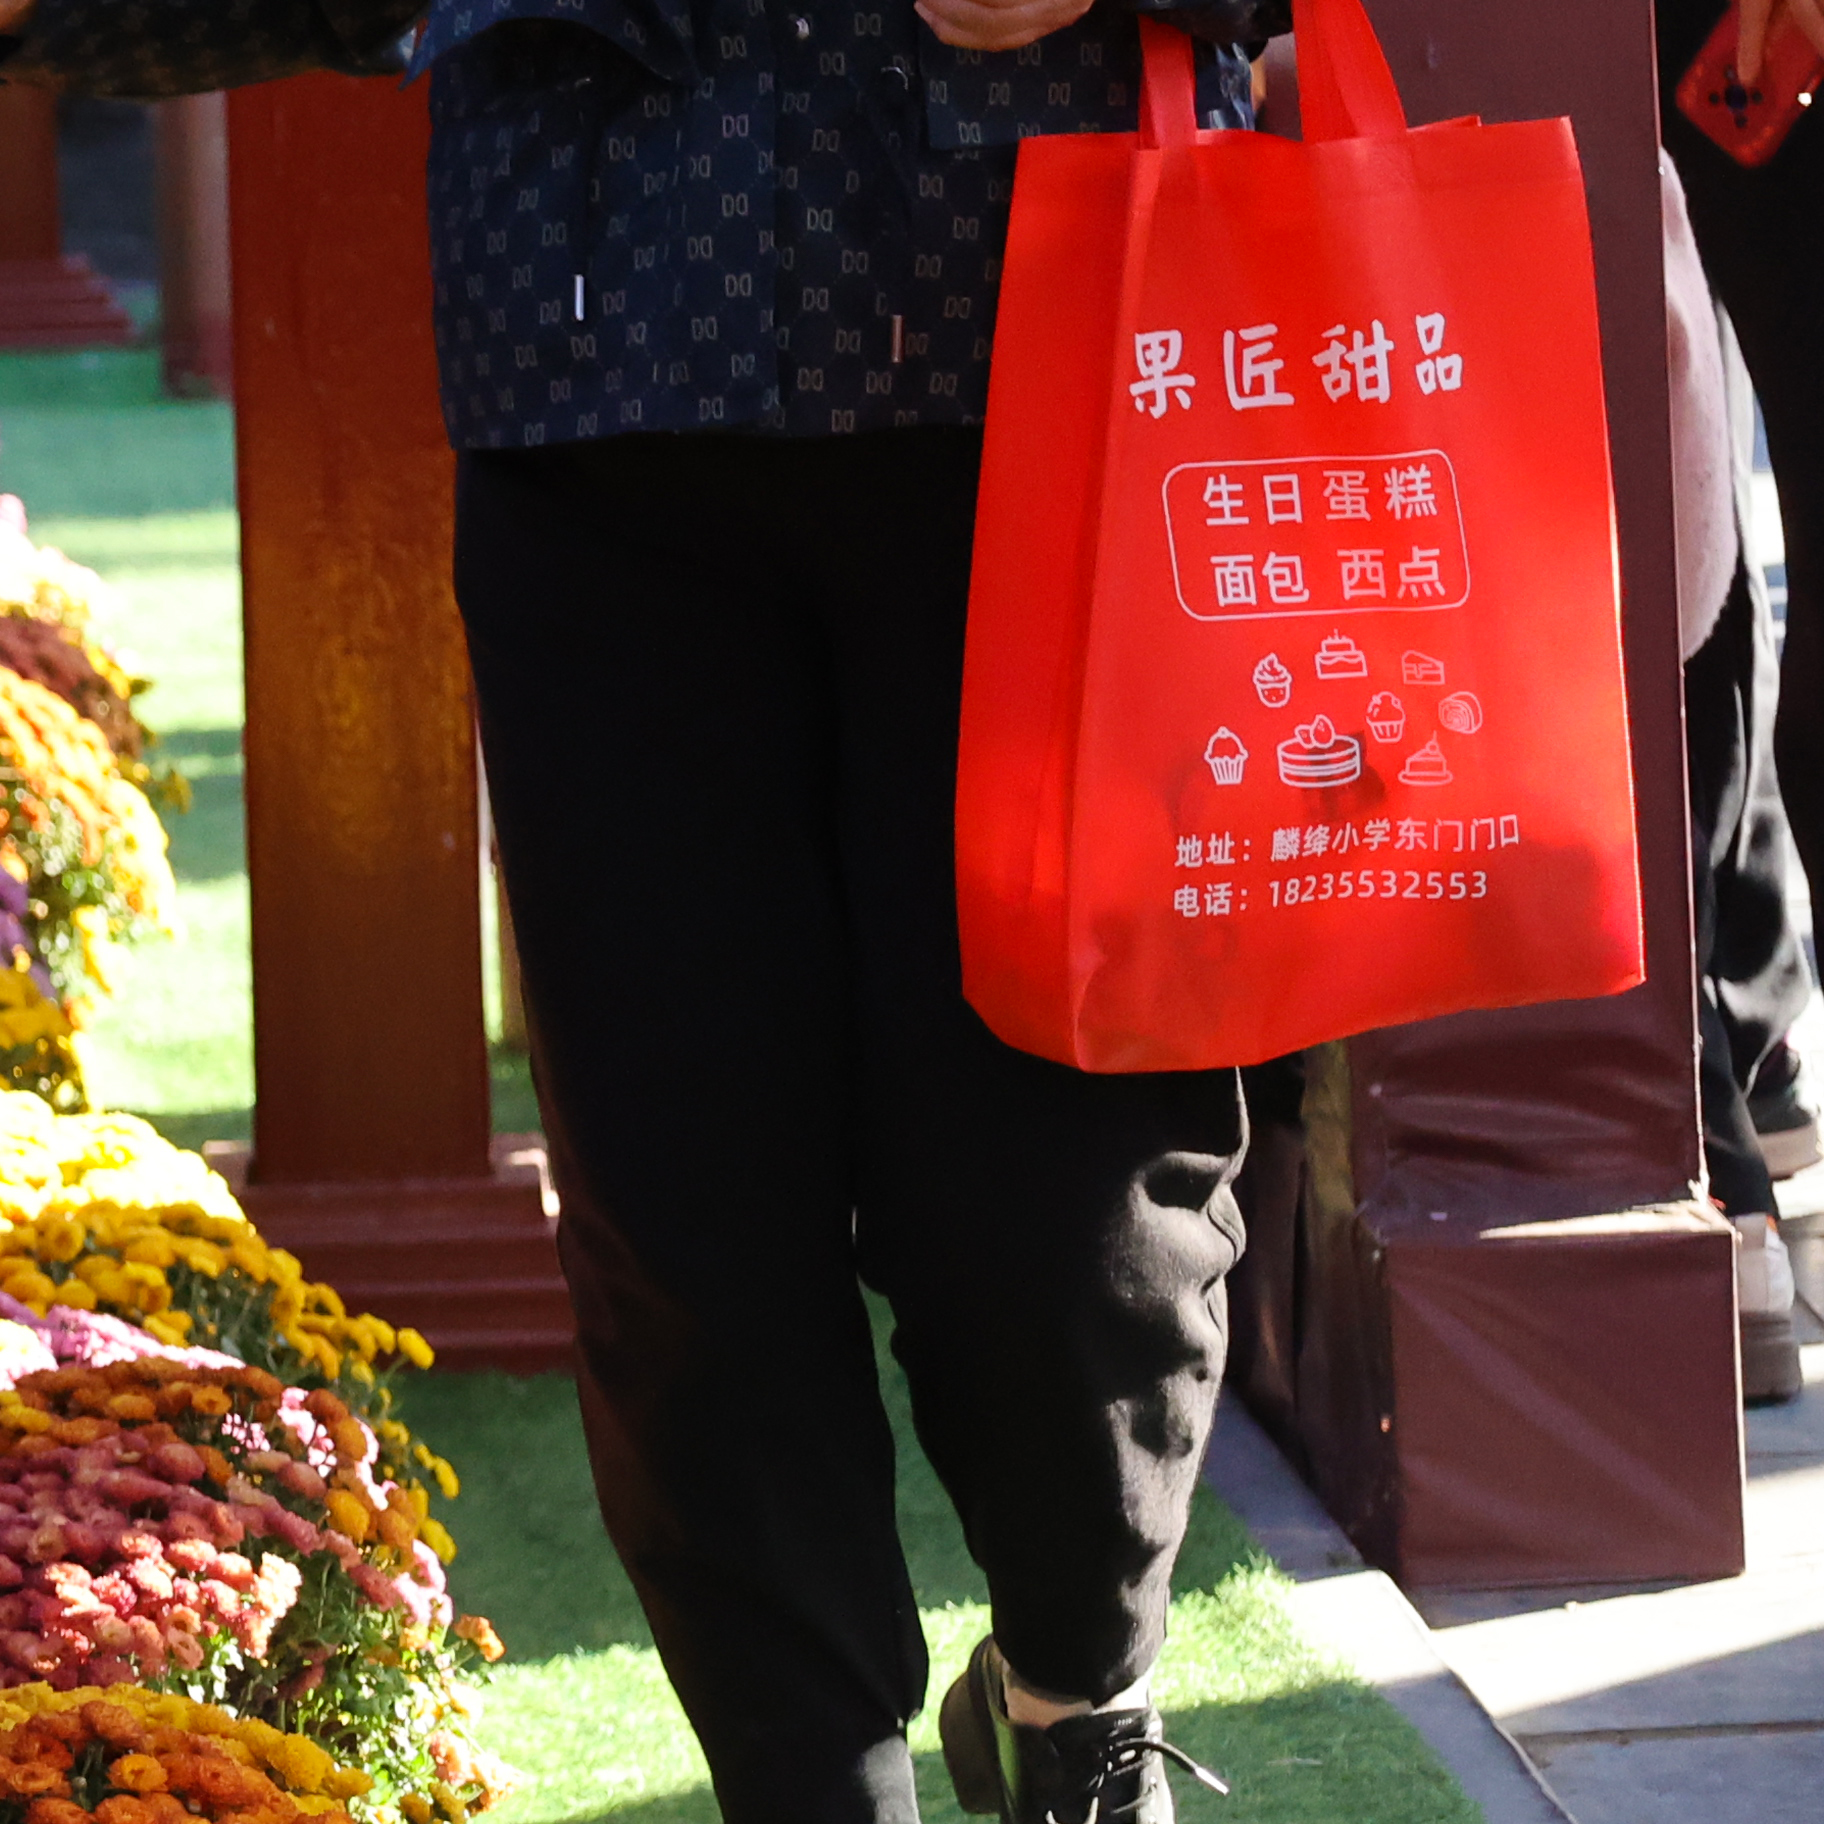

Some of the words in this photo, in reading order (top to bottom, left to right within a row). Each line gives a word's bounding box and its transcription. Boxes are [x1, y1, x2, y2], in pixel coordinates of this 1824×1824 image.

[1129, 311, 1463, 419] 果匠甜品
[1202, 463, 1438, 526] 生日蛋糕
[1209, 551, 1310, 607] 面包
[1337, 545, 1446, 600] 西点
